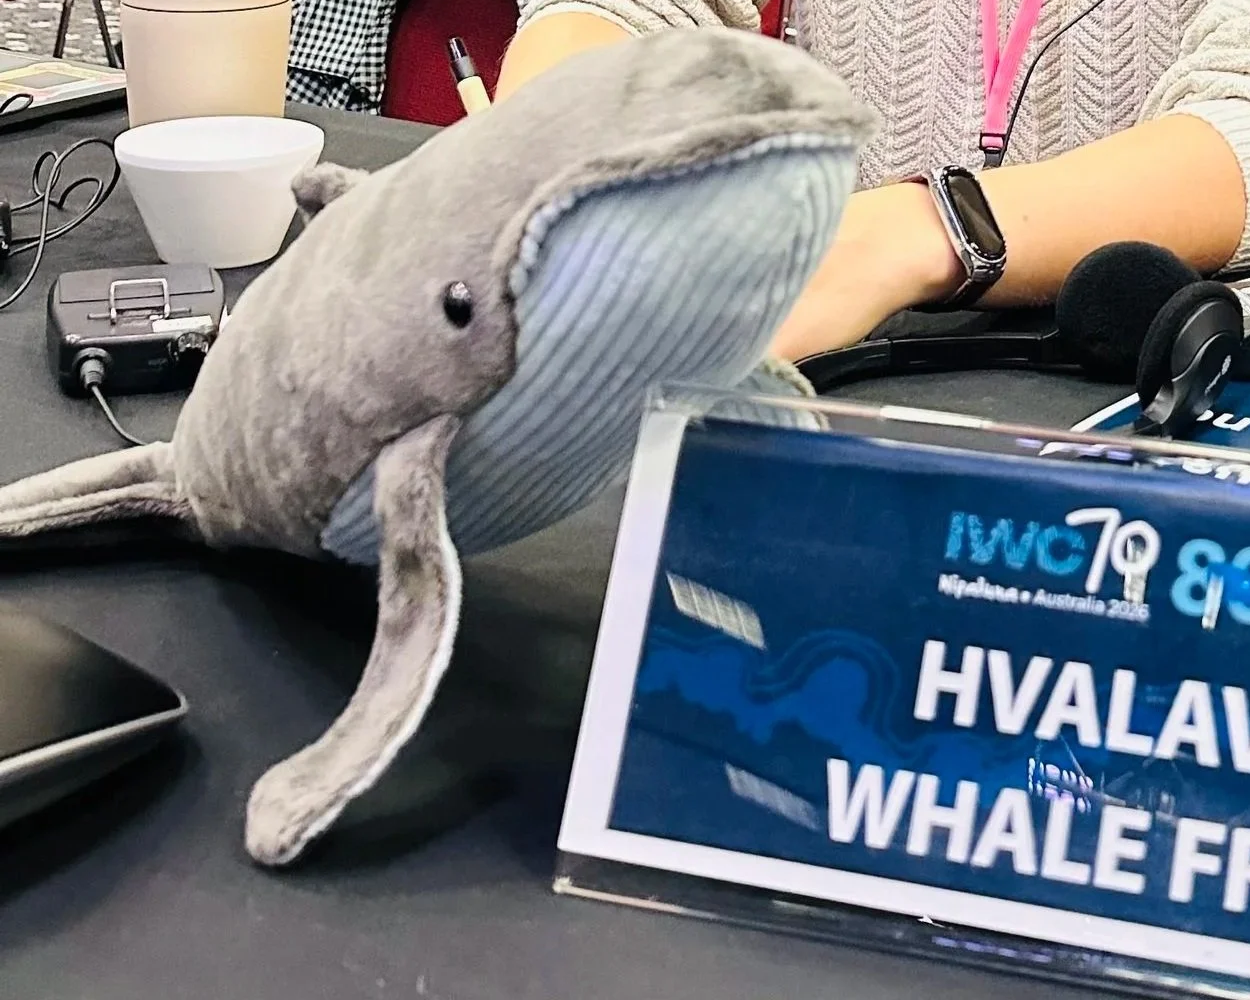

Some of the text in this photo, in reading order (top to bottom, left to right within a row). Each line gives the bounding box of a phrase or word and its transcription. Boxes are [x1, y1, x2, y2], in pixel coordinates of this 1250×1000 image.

[1032, 588, 1106, 616] Australia
[1106, 600, 1151, 624] 2026
[826, 757, 1154, 894] WHALE
